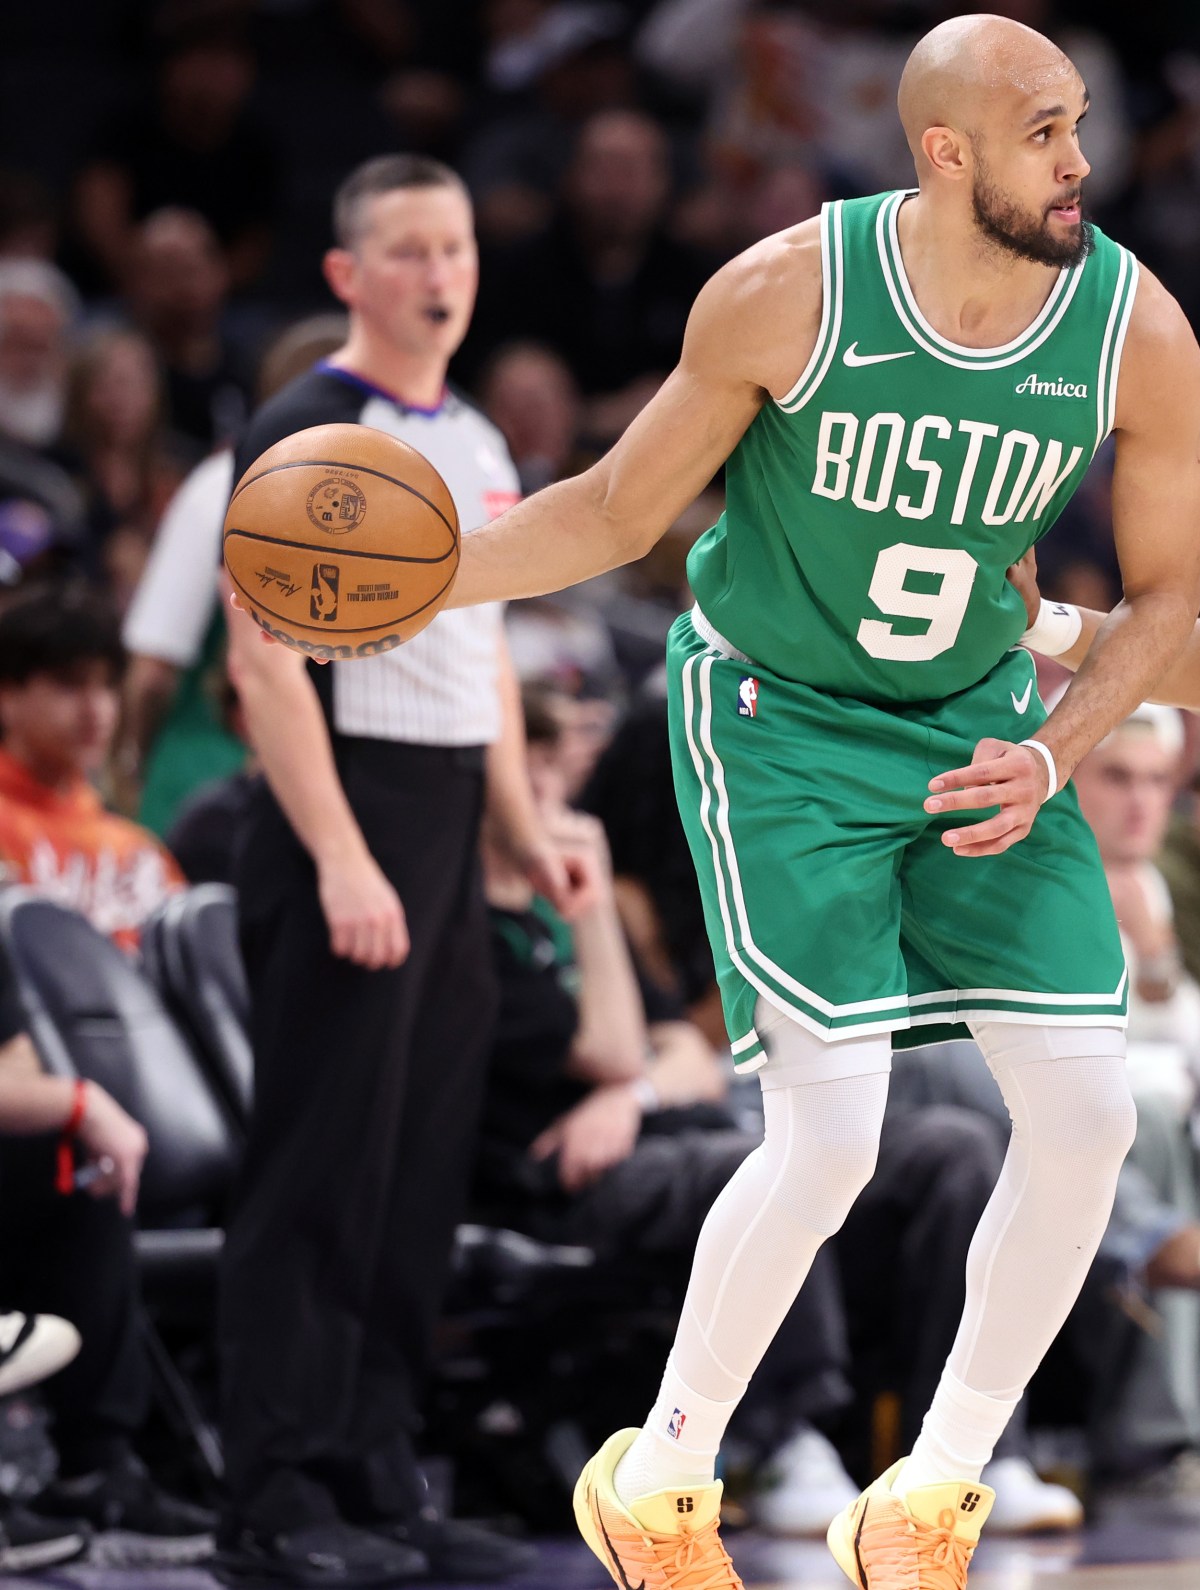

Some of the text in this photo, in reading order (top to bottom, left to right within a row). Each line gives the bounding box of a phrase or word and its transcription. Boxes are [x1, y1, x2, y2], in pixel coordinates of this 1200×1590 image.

[1015, 373, 1088, 398] Amica
[810, 411, 1084, 525] BOSTON
[856, 542, 979, 662] 9
